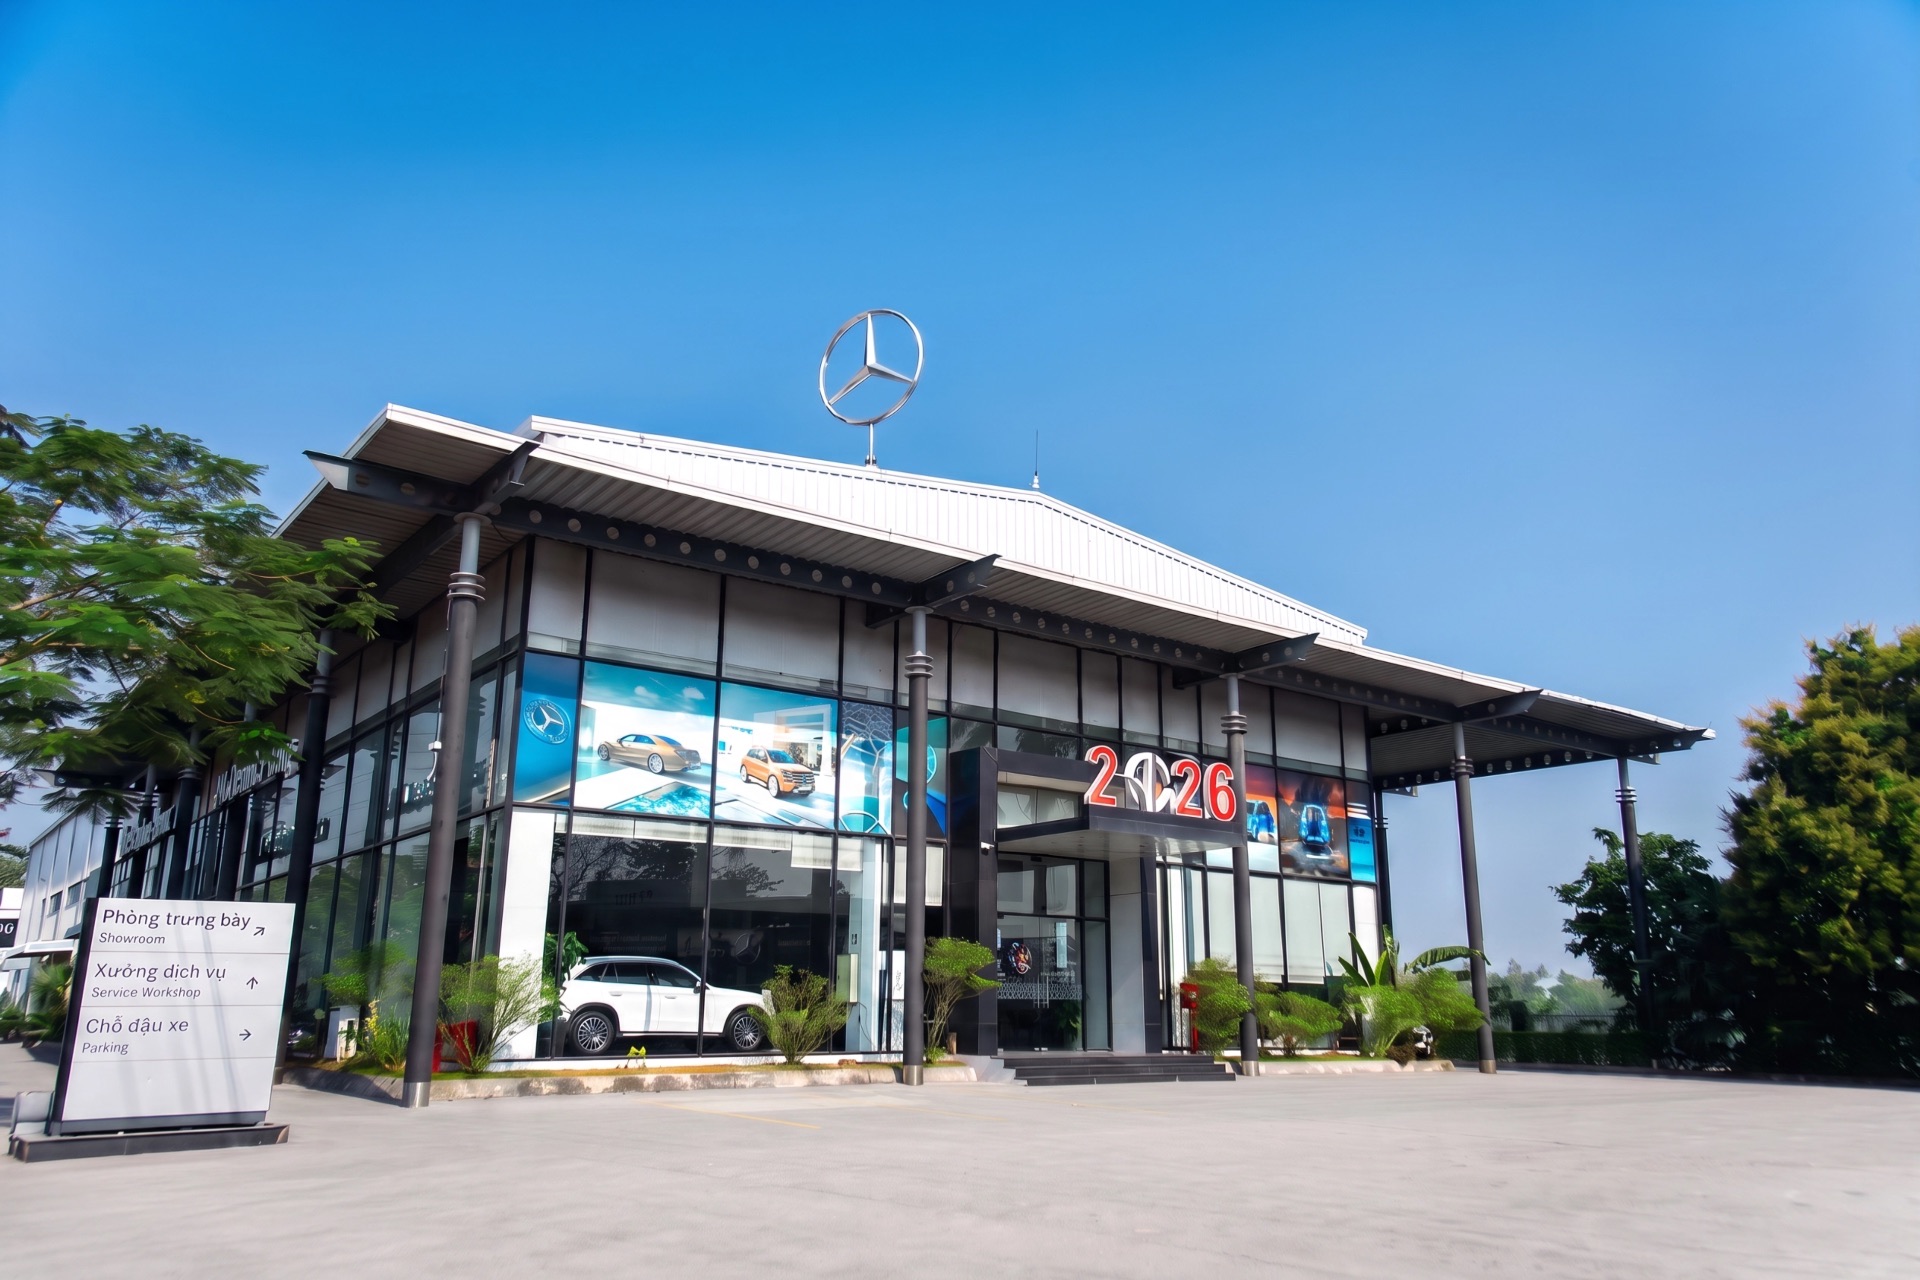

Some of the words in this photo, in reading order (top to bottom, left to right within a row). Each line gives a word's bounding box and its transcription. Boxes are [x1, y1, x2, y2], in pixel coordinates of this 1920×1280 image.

[102, 909, 160, 929] Phòng
[166, 911, 216, 930] trưng
[220, 912, 251, 930] bày
[98, 932, 166, 944] Showroom
[94, 963, 158, 982] Xưởng
[163, 963, 200, 982] dịch
[206, 967, 226, 982] vụ
[91, 986, 138, 998] Service
[141, 986, 201, 1000] Workshop
[86, 1015, 122, 1034] Chỗ
[128, 1018, 162, 1036] đậu
[168, 1020, 189, 1033] xe
[82, 1042, 129, 1056] Parking
